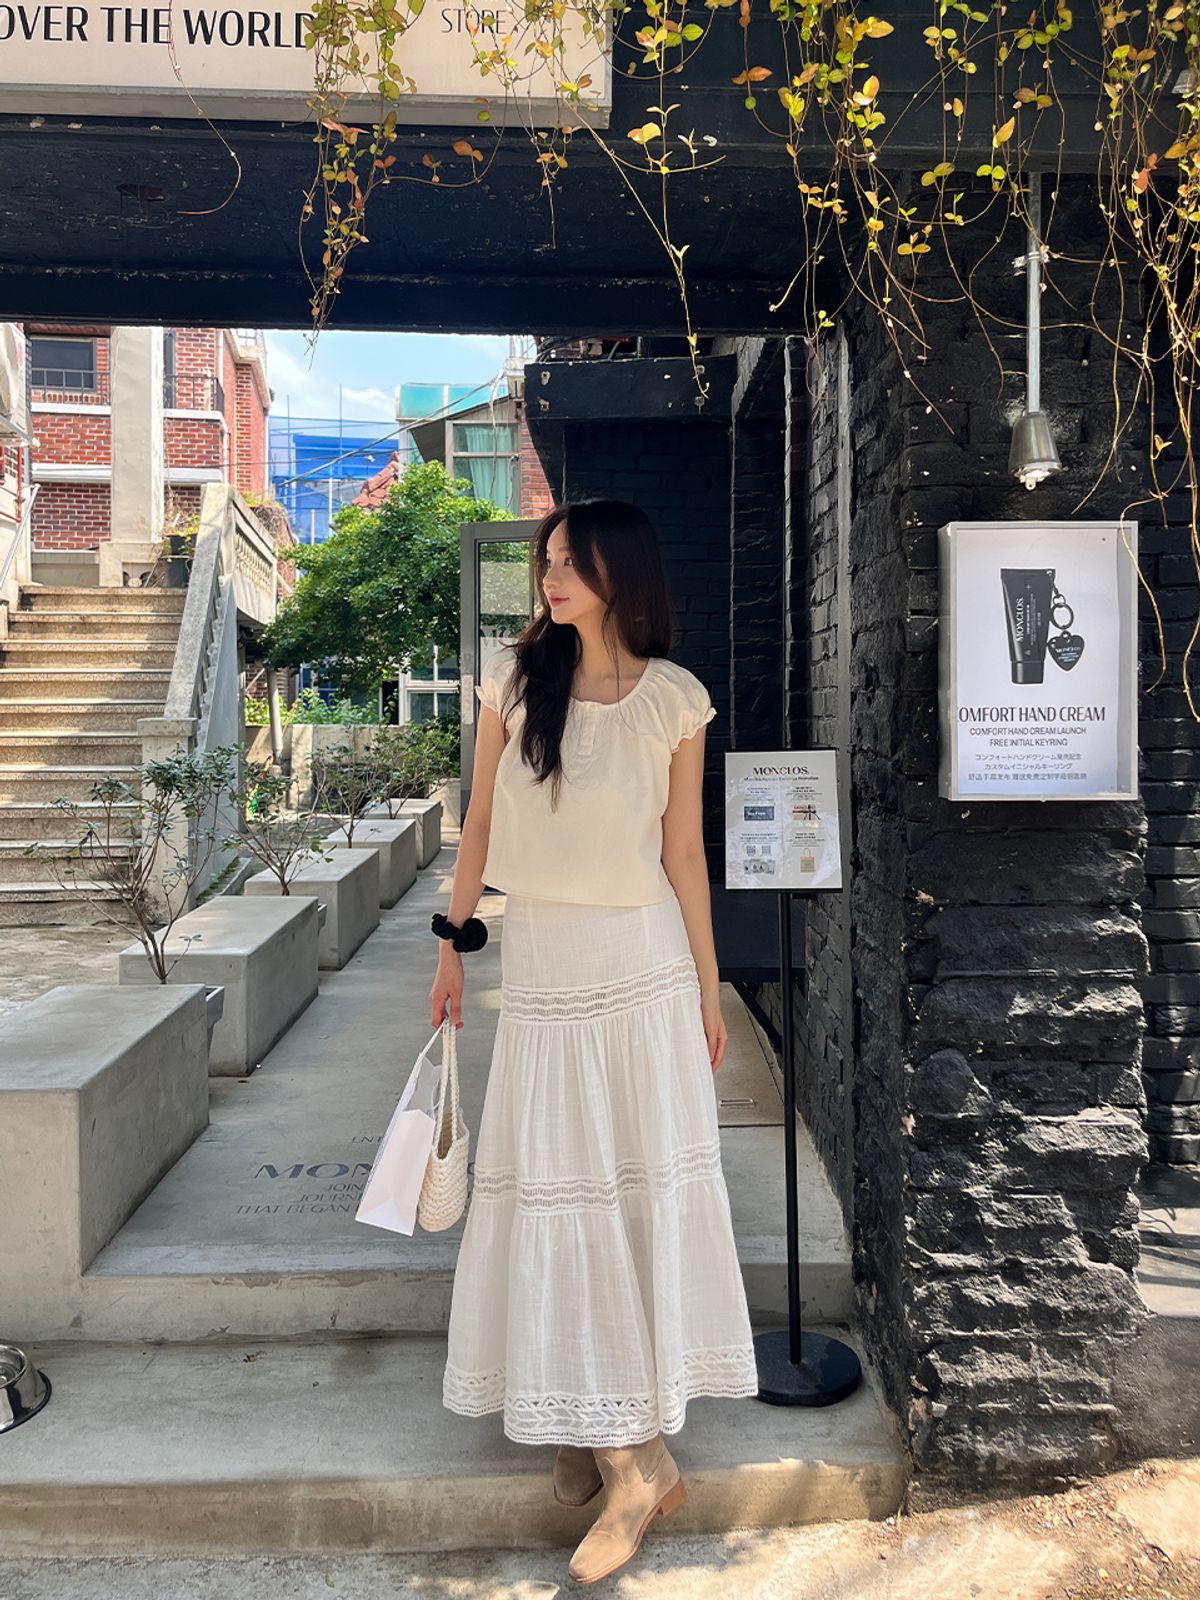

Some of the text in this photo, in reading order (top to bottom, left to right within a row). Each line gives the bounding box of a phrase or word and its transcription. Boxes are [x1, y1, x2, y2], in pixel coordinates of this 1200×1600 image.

[100, 7, 172, 43] THE
[441, 8, 507, 35] STORE
[957, 706, 1106, 723] OMFORT HAND CREAM
[970, 727, 1087, 736] COMFORT HAND CREAM LAUNCH
[989, 738, 1068, 747] FREE INITIAL KEYRING
